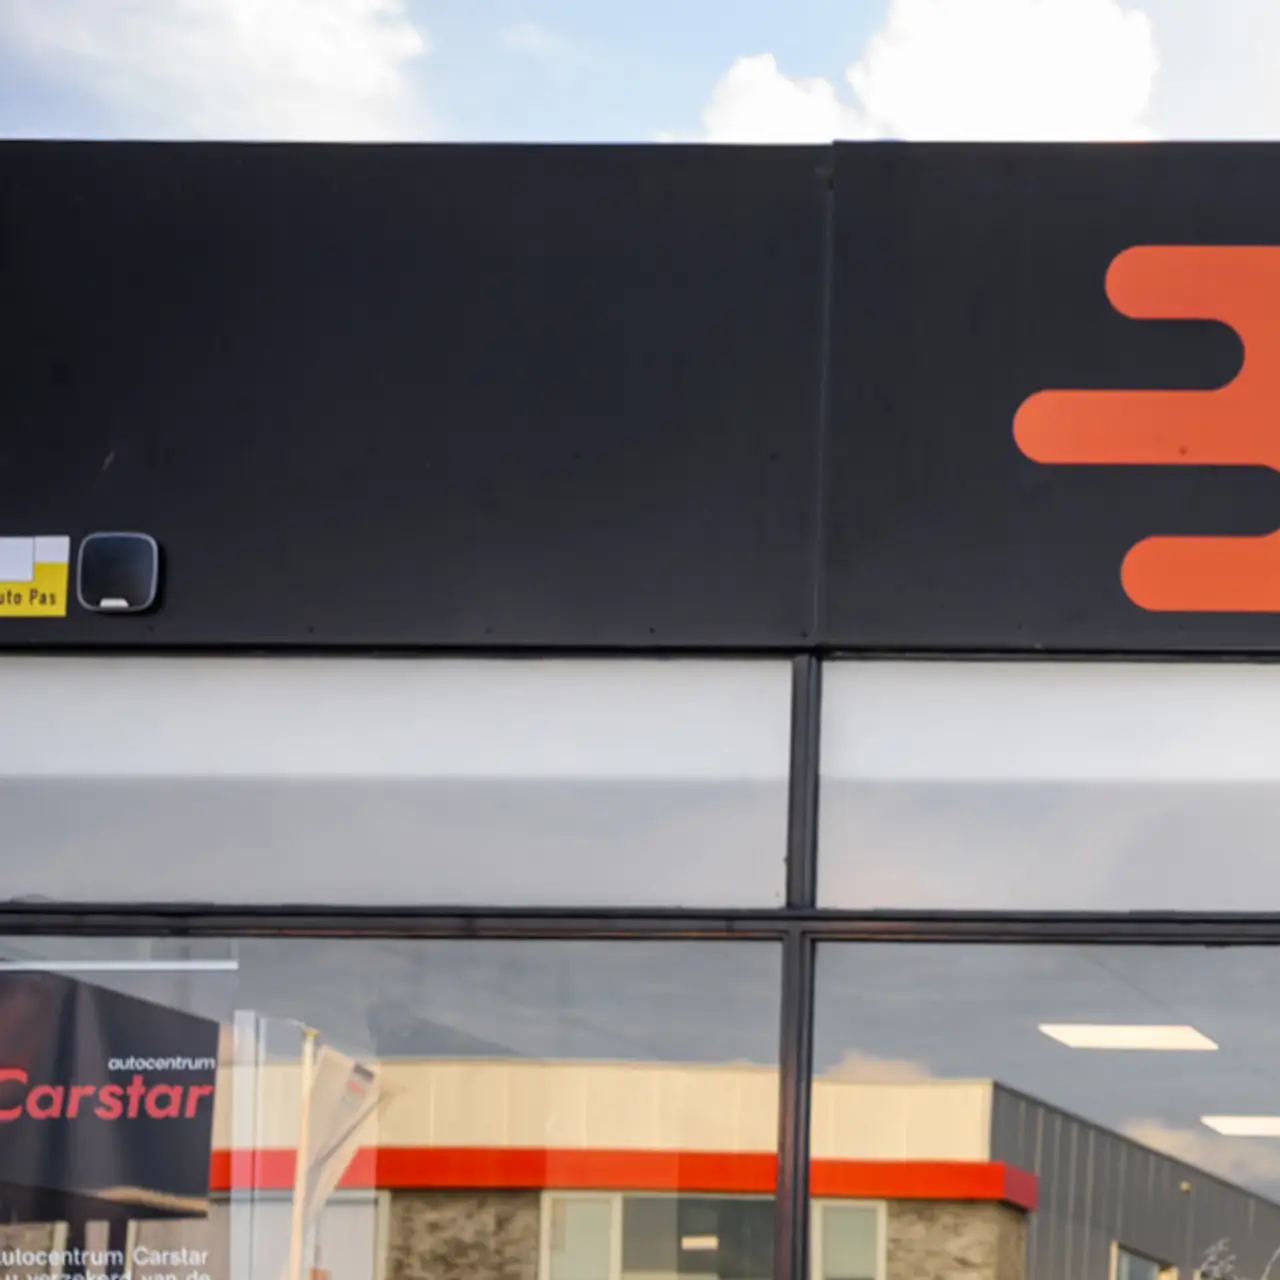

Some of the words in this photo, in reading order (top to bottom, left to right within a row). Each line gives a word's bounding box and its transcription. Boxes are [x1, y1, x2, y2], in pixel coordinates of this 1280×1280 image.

[29, 588, 57, 605] Pas
[108, 1055, 216, 1070] autocentrum
[0, 1249, 124, 1267] utocentrum
[132, 1247, 209, 1267] Carstar
